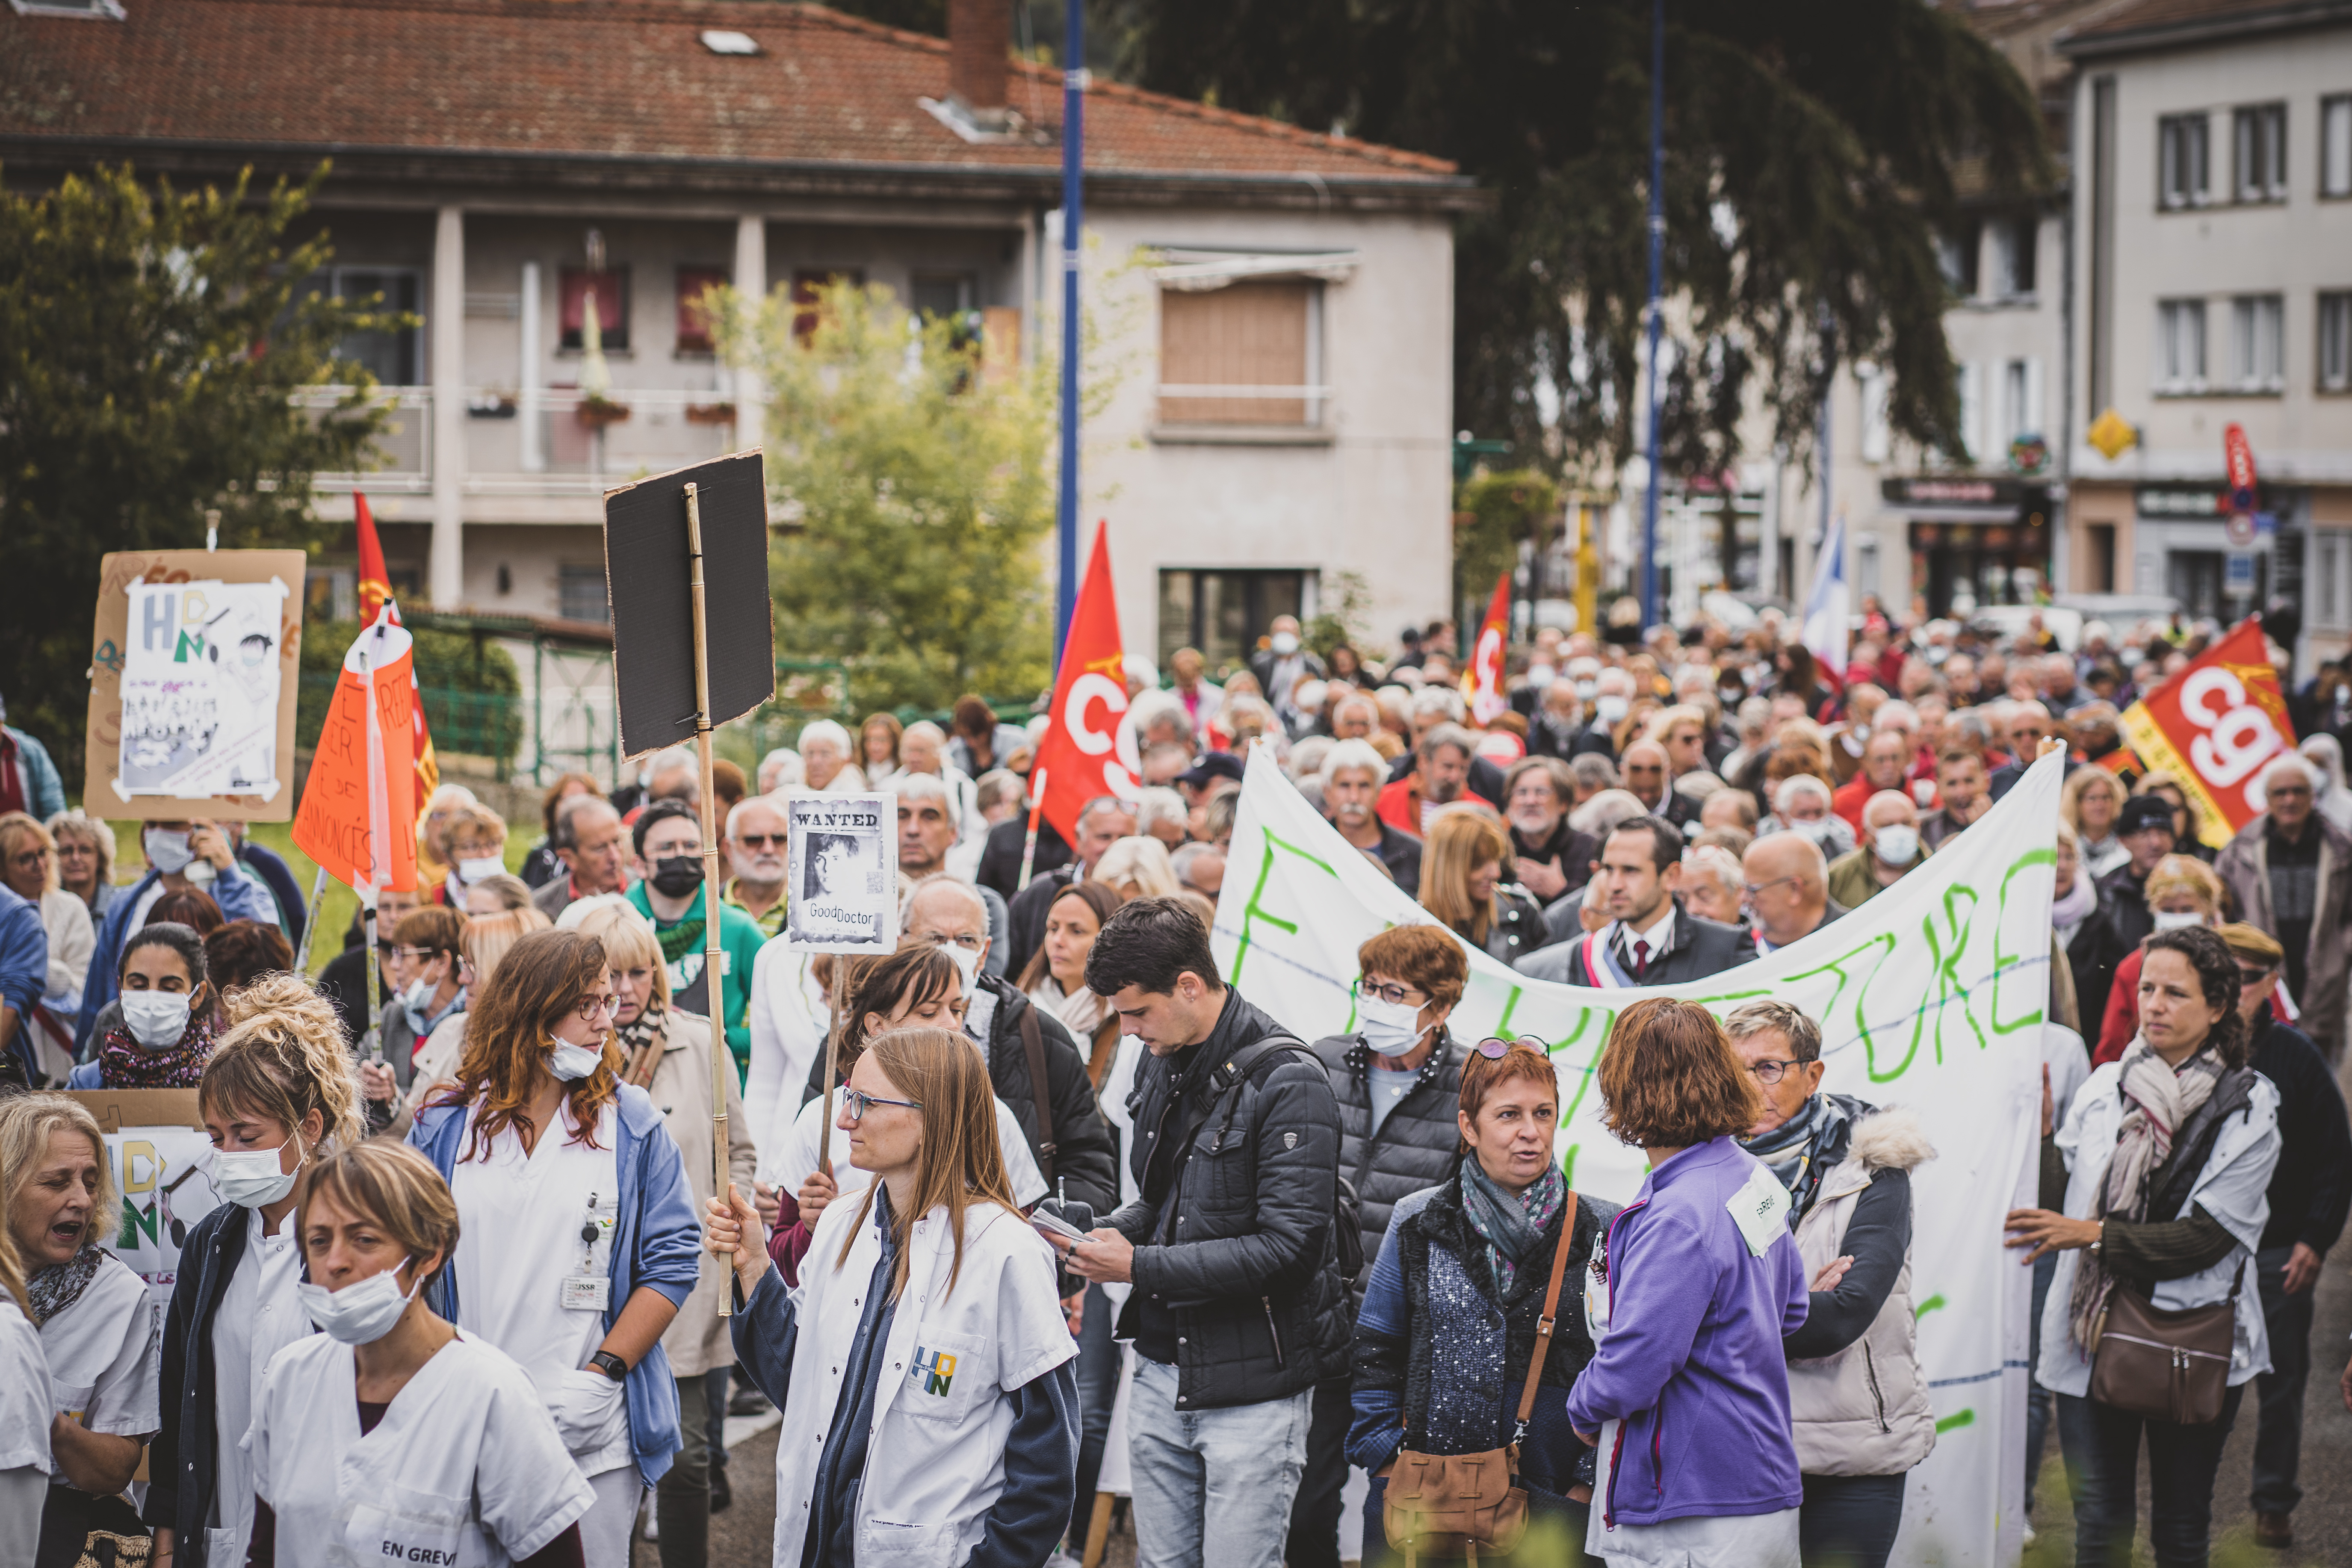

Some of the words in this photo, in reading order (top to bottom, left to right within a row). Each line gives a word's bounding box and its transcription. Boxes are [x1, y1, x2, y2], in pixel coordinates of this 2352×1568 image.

[796, 813, 878, 827] WANTED
[810, 903, 873, 924] GoodDoctor
[911, 1346, 957, 1397] HDN
[382, 1541, 404, 1559] EN
